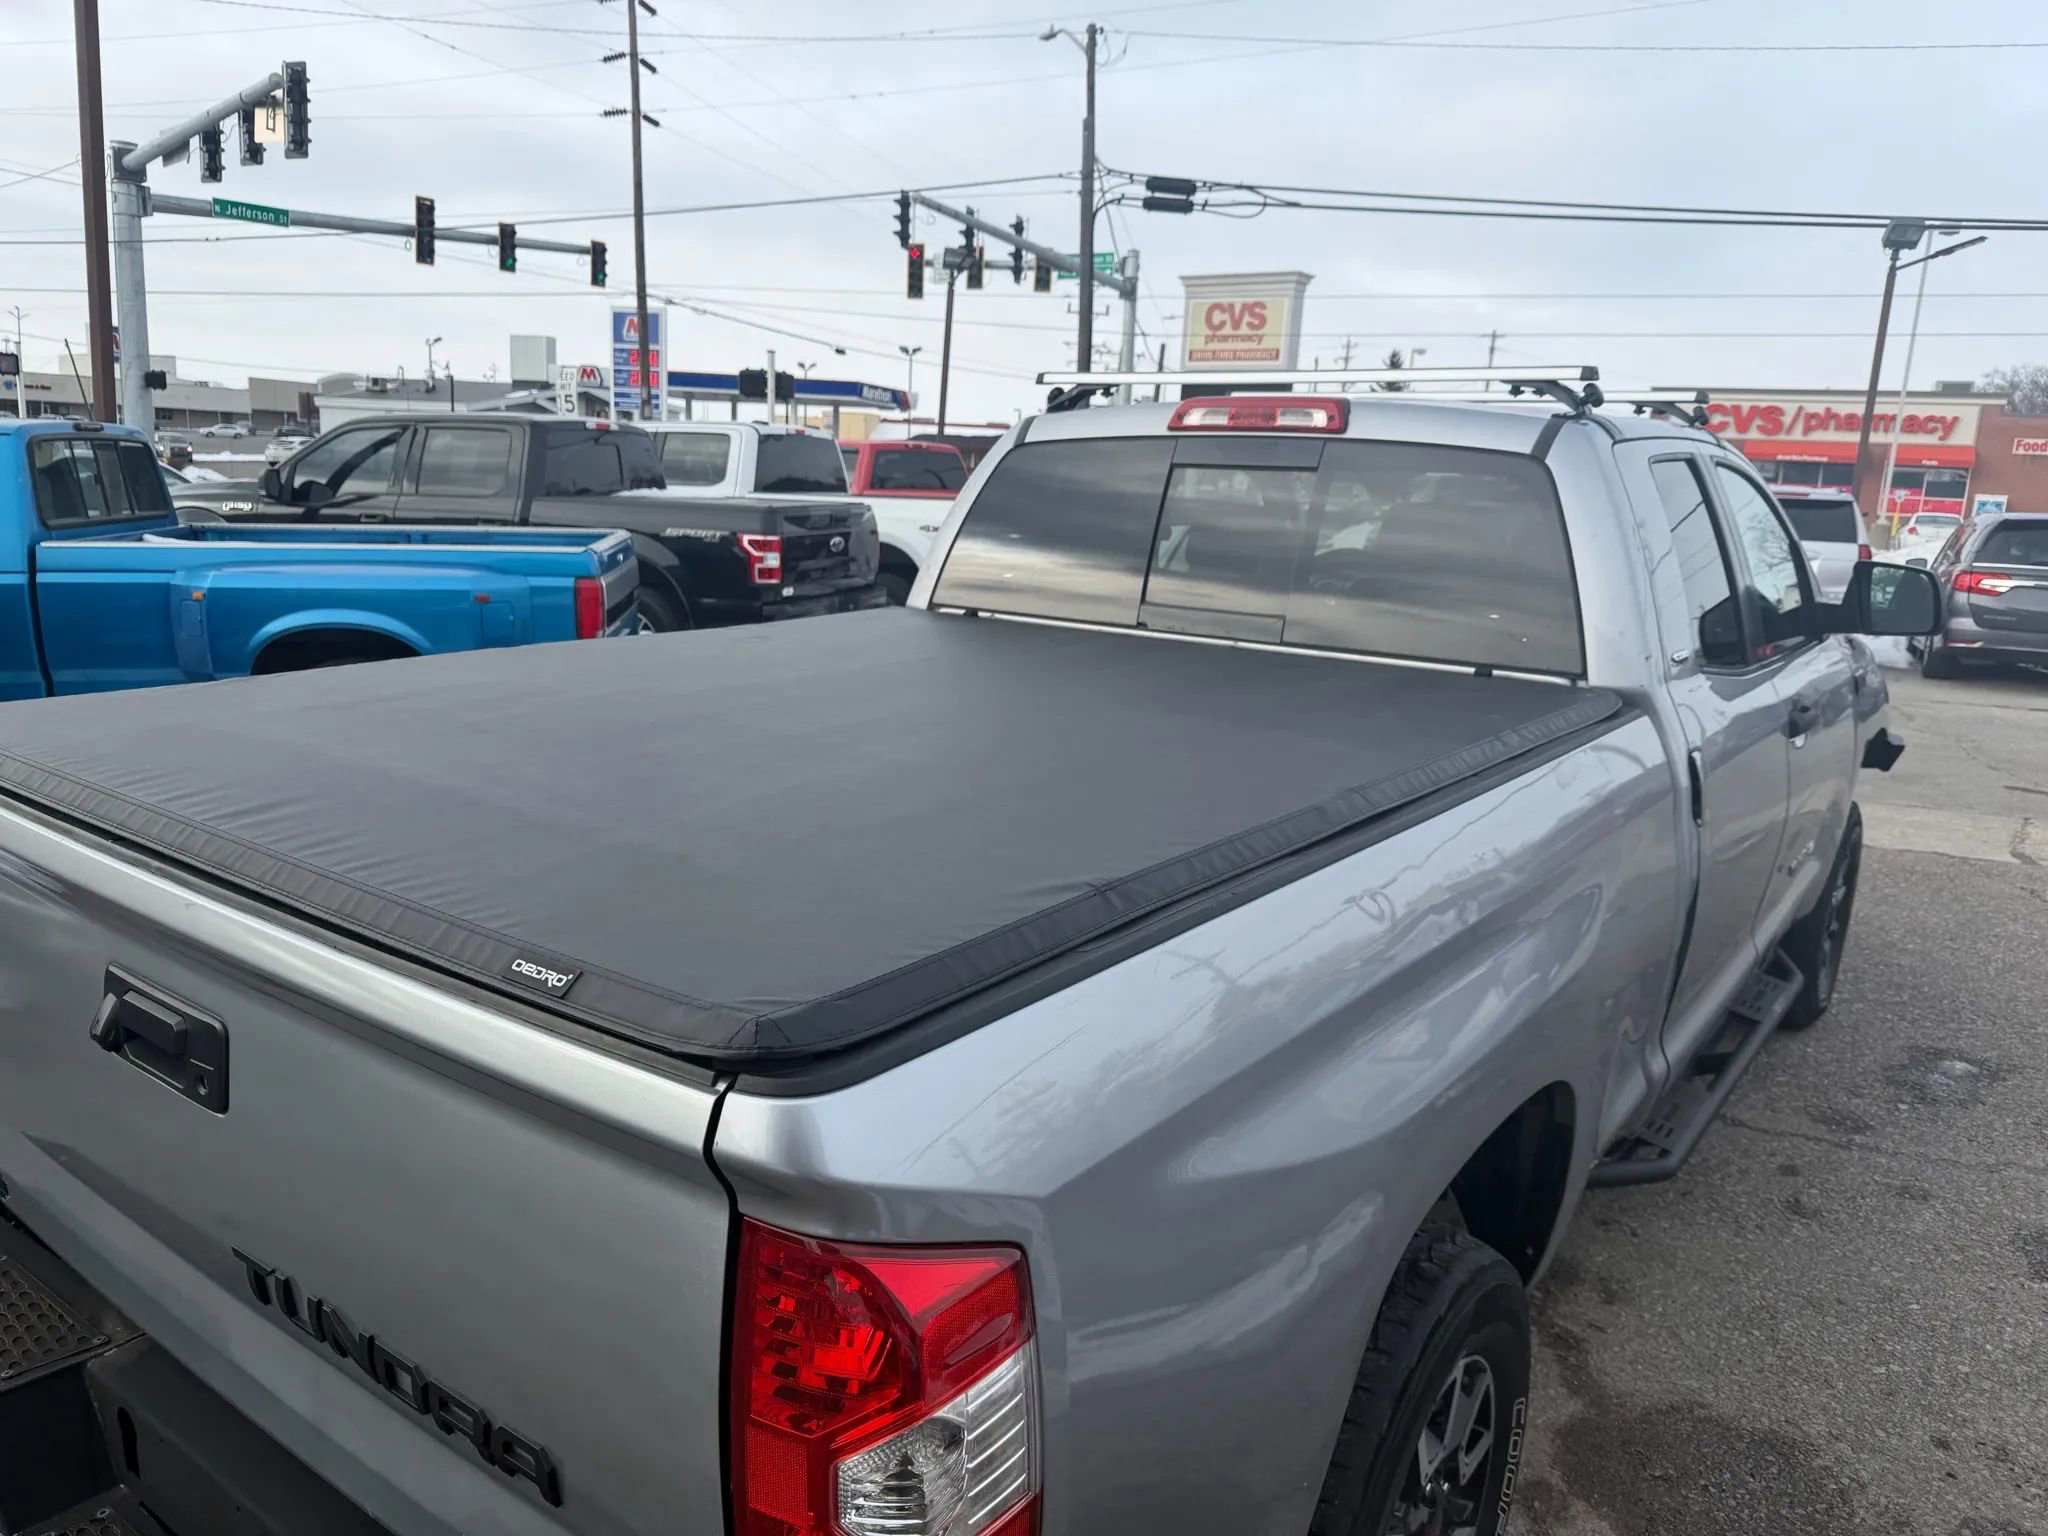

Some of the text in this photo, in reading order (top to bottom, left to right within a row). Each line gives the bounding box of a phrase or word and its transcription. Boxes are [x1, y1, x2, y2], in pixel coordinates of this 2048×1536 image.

[225, 203, 275, 222] Jefferson
[1205, 301, 1267, 332] CVS
[1204, 333, 1265, 347] pharmacy
[231, 1245, 563, 1508] TUNDRA
